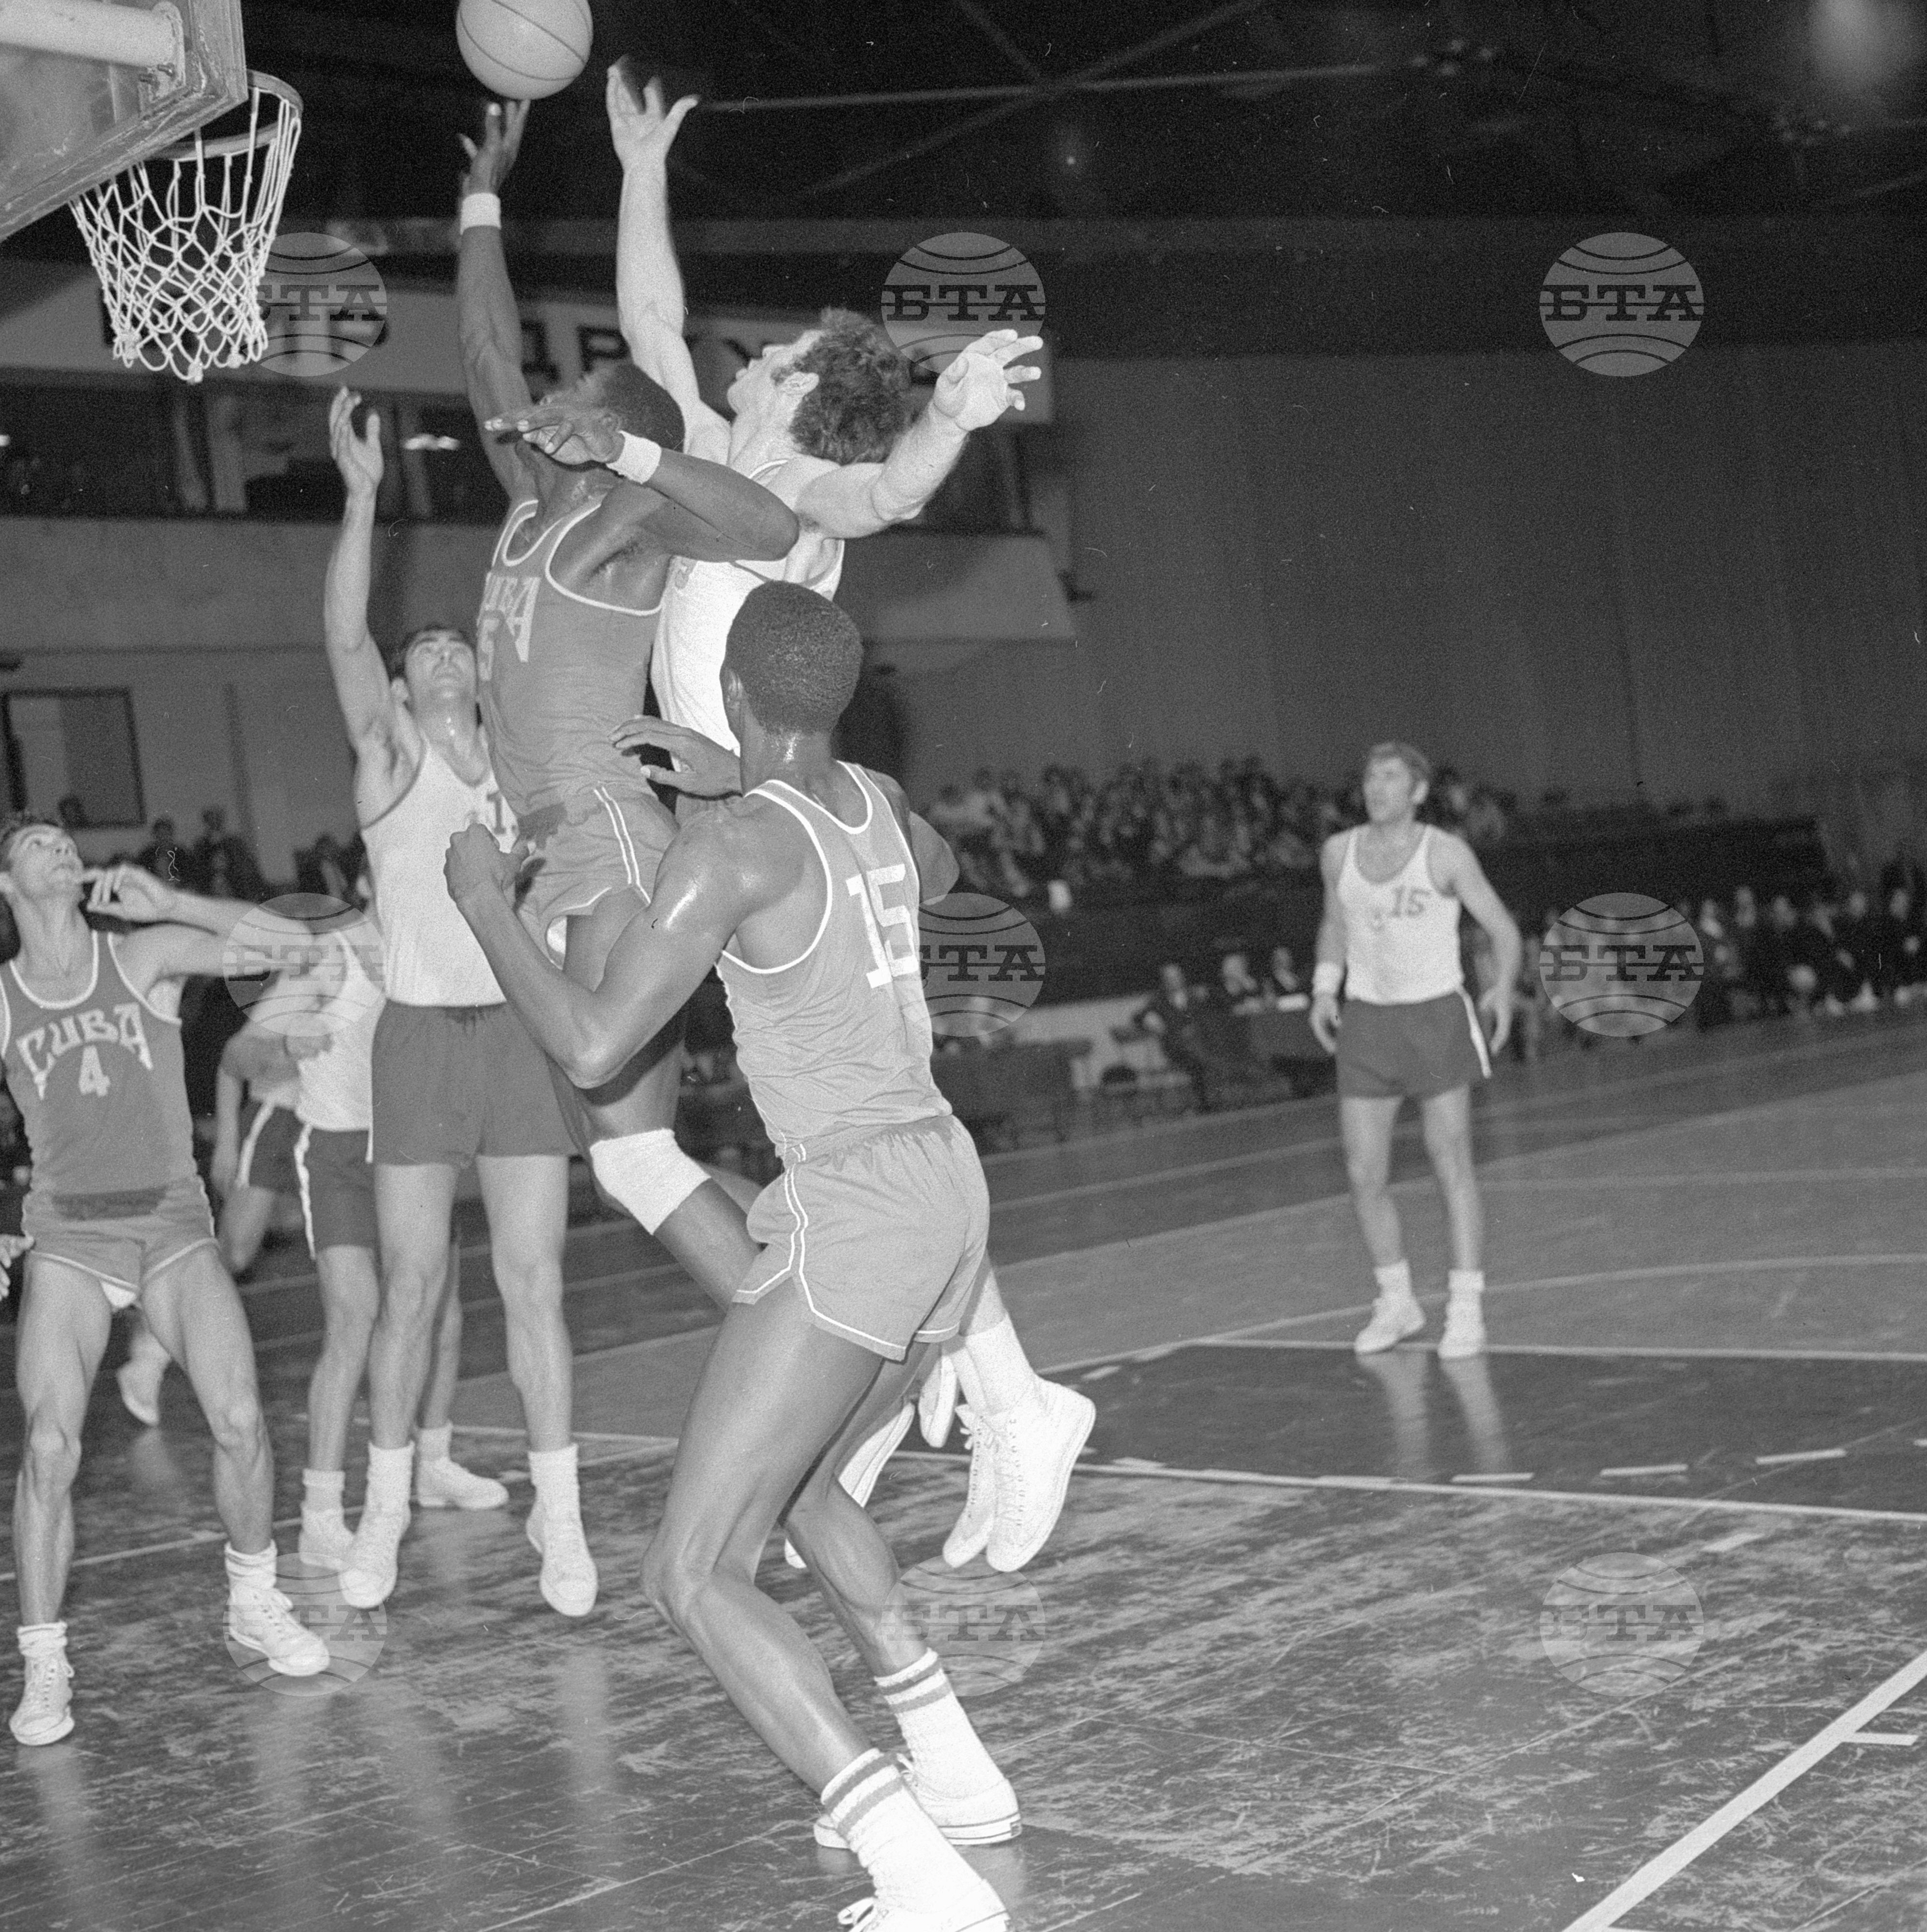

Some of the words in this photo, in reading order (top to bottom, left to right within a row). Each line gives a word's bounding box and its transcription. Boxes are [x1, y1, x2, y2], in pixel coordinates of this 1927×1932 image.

[845, 864, 919, 989] 15
[1388, 886, 1430, 917] 15
[15, 1002, 154, 1100] CUBA
[78, 1045, 111, 1097] 4
